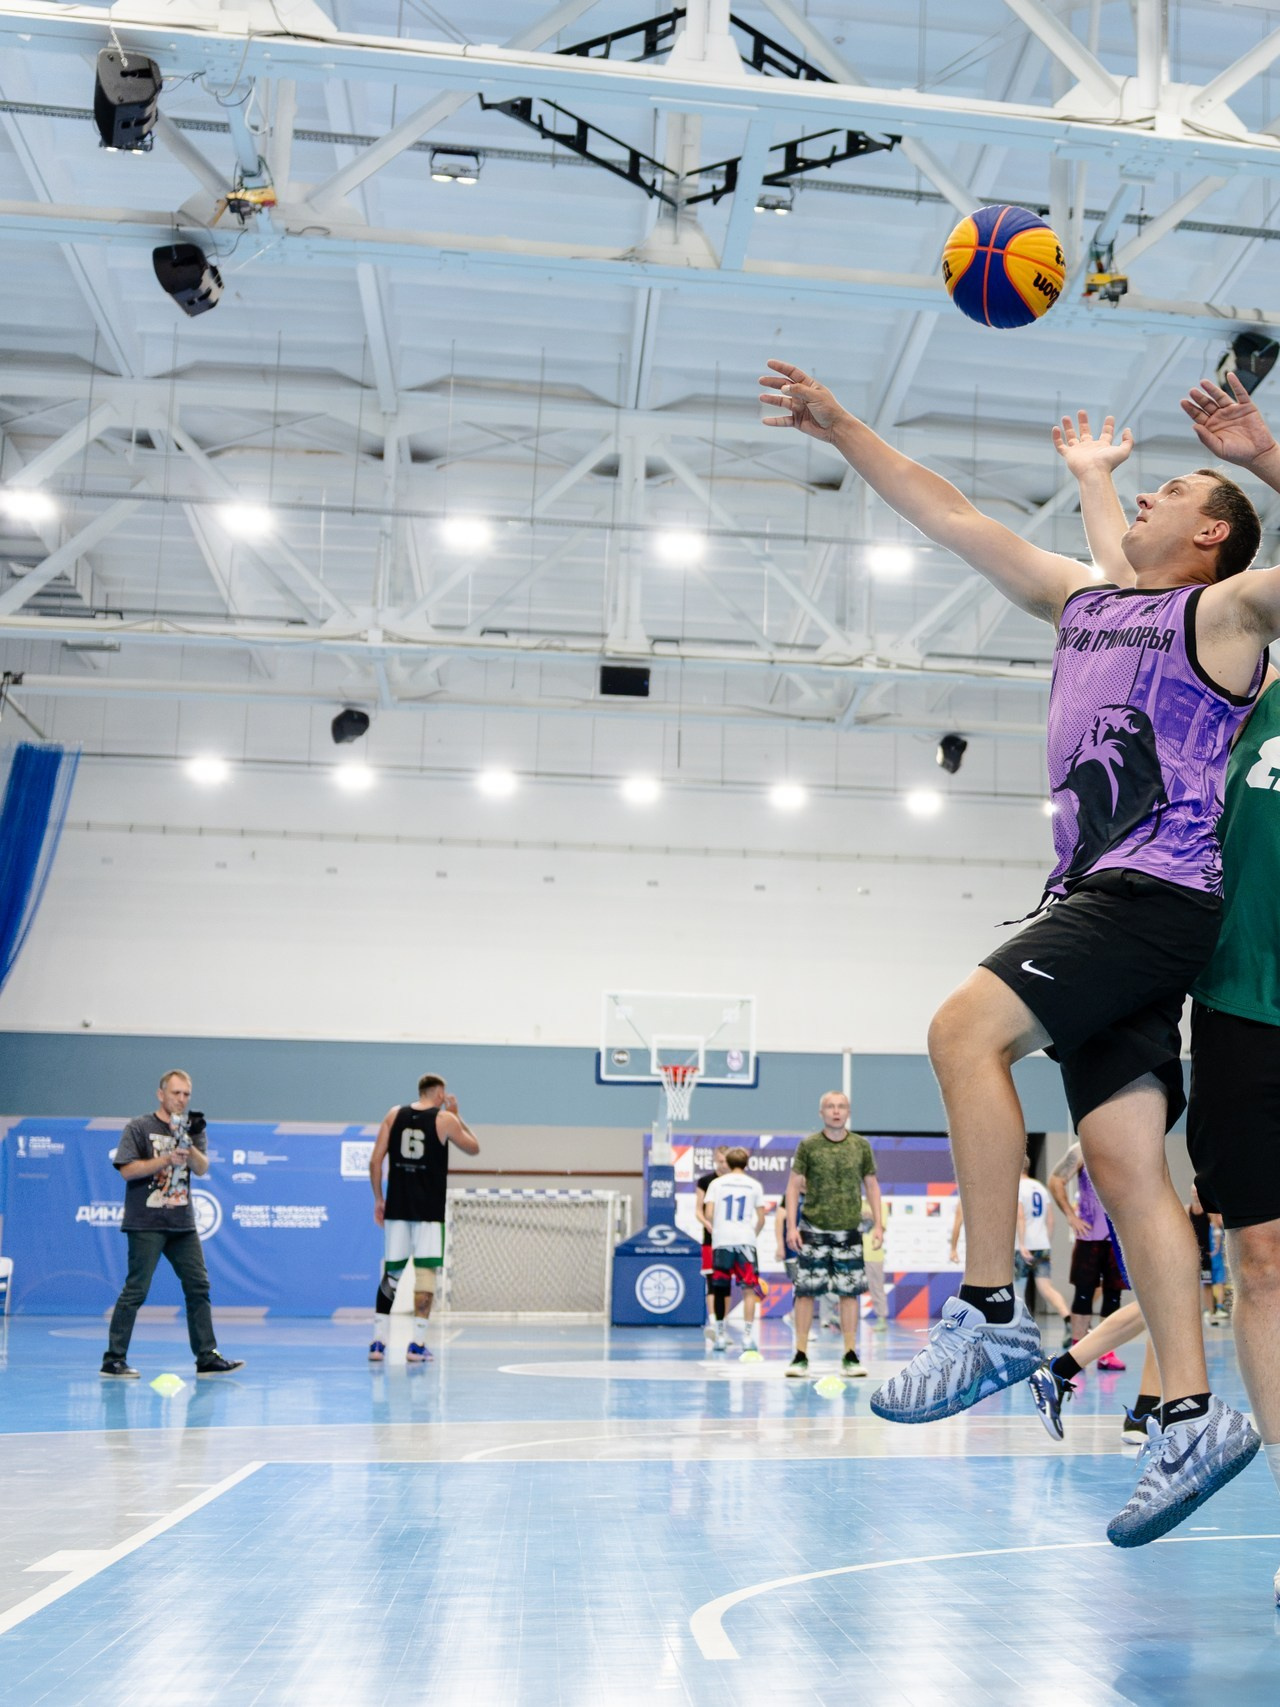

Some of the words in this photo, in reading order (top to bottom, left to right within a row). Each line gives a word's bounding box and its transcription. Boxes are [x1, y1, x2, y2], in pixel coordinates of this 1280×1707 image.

[1091, 625, 1176, 653] ПРИМОРЬЯ
[401, 1128, 425, 1160] 6
[722, 1194, 747, 1222] 11
[1032, 1192, 1043, 1217] 9
